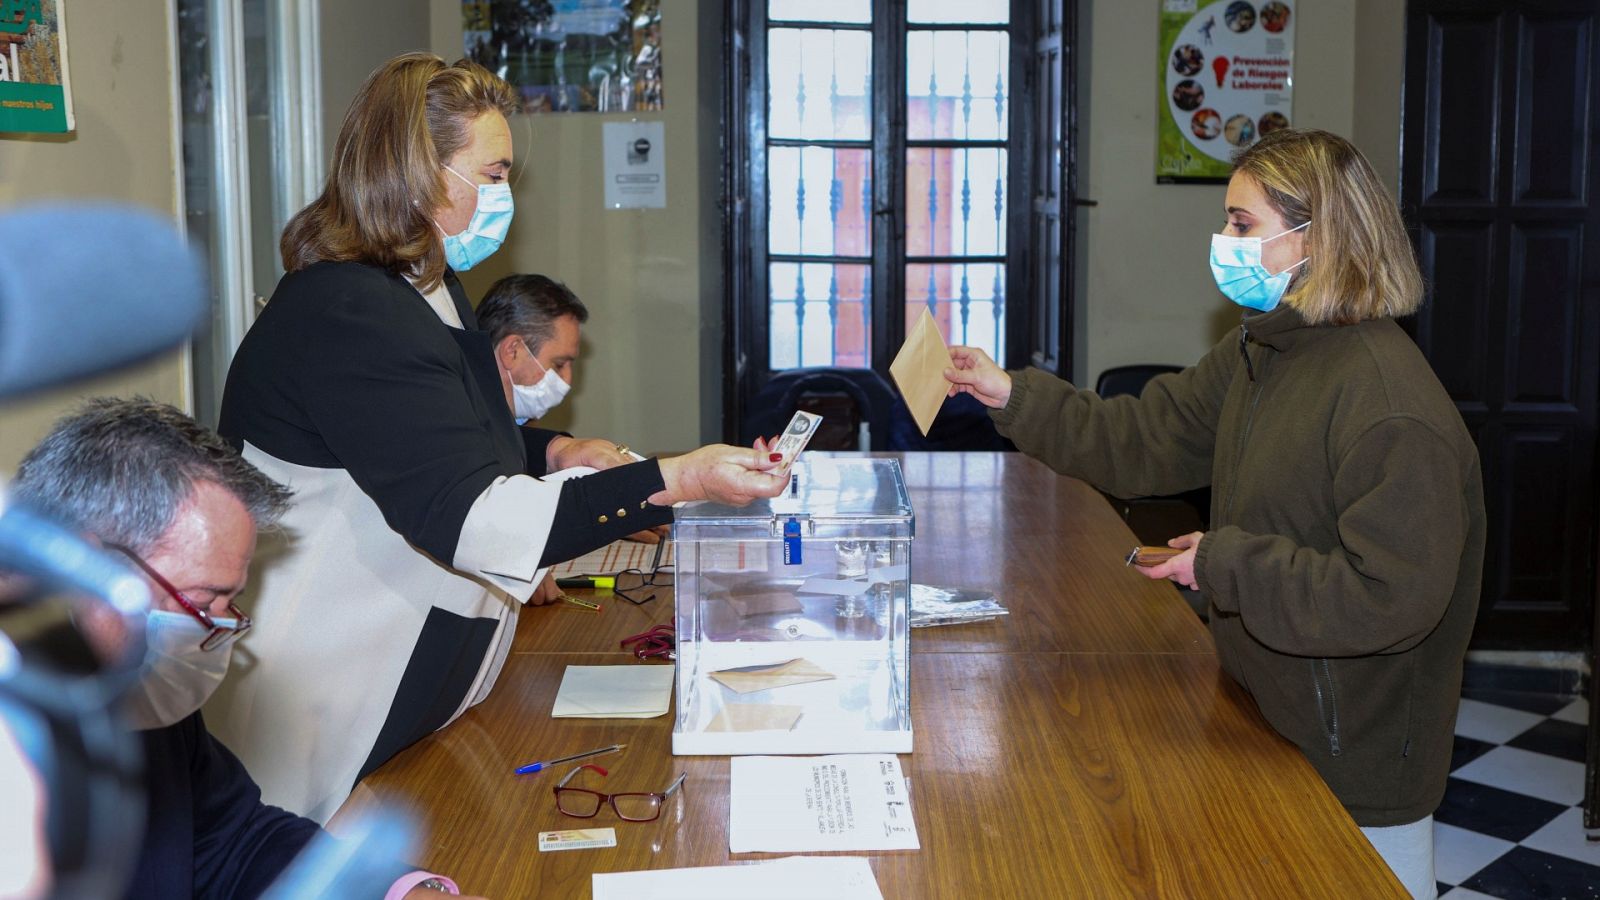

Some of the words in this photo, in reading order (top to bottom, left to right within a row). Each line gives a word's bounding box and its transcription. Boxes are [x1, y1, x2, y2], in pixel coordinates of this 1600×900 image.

[1232, 55, 1290, 66] Prevención
[1232, 69, 1246, 78] de
[1248, 68, 1288, 80] Riesgos
[1231, 79, 1284, 91] Laborales
